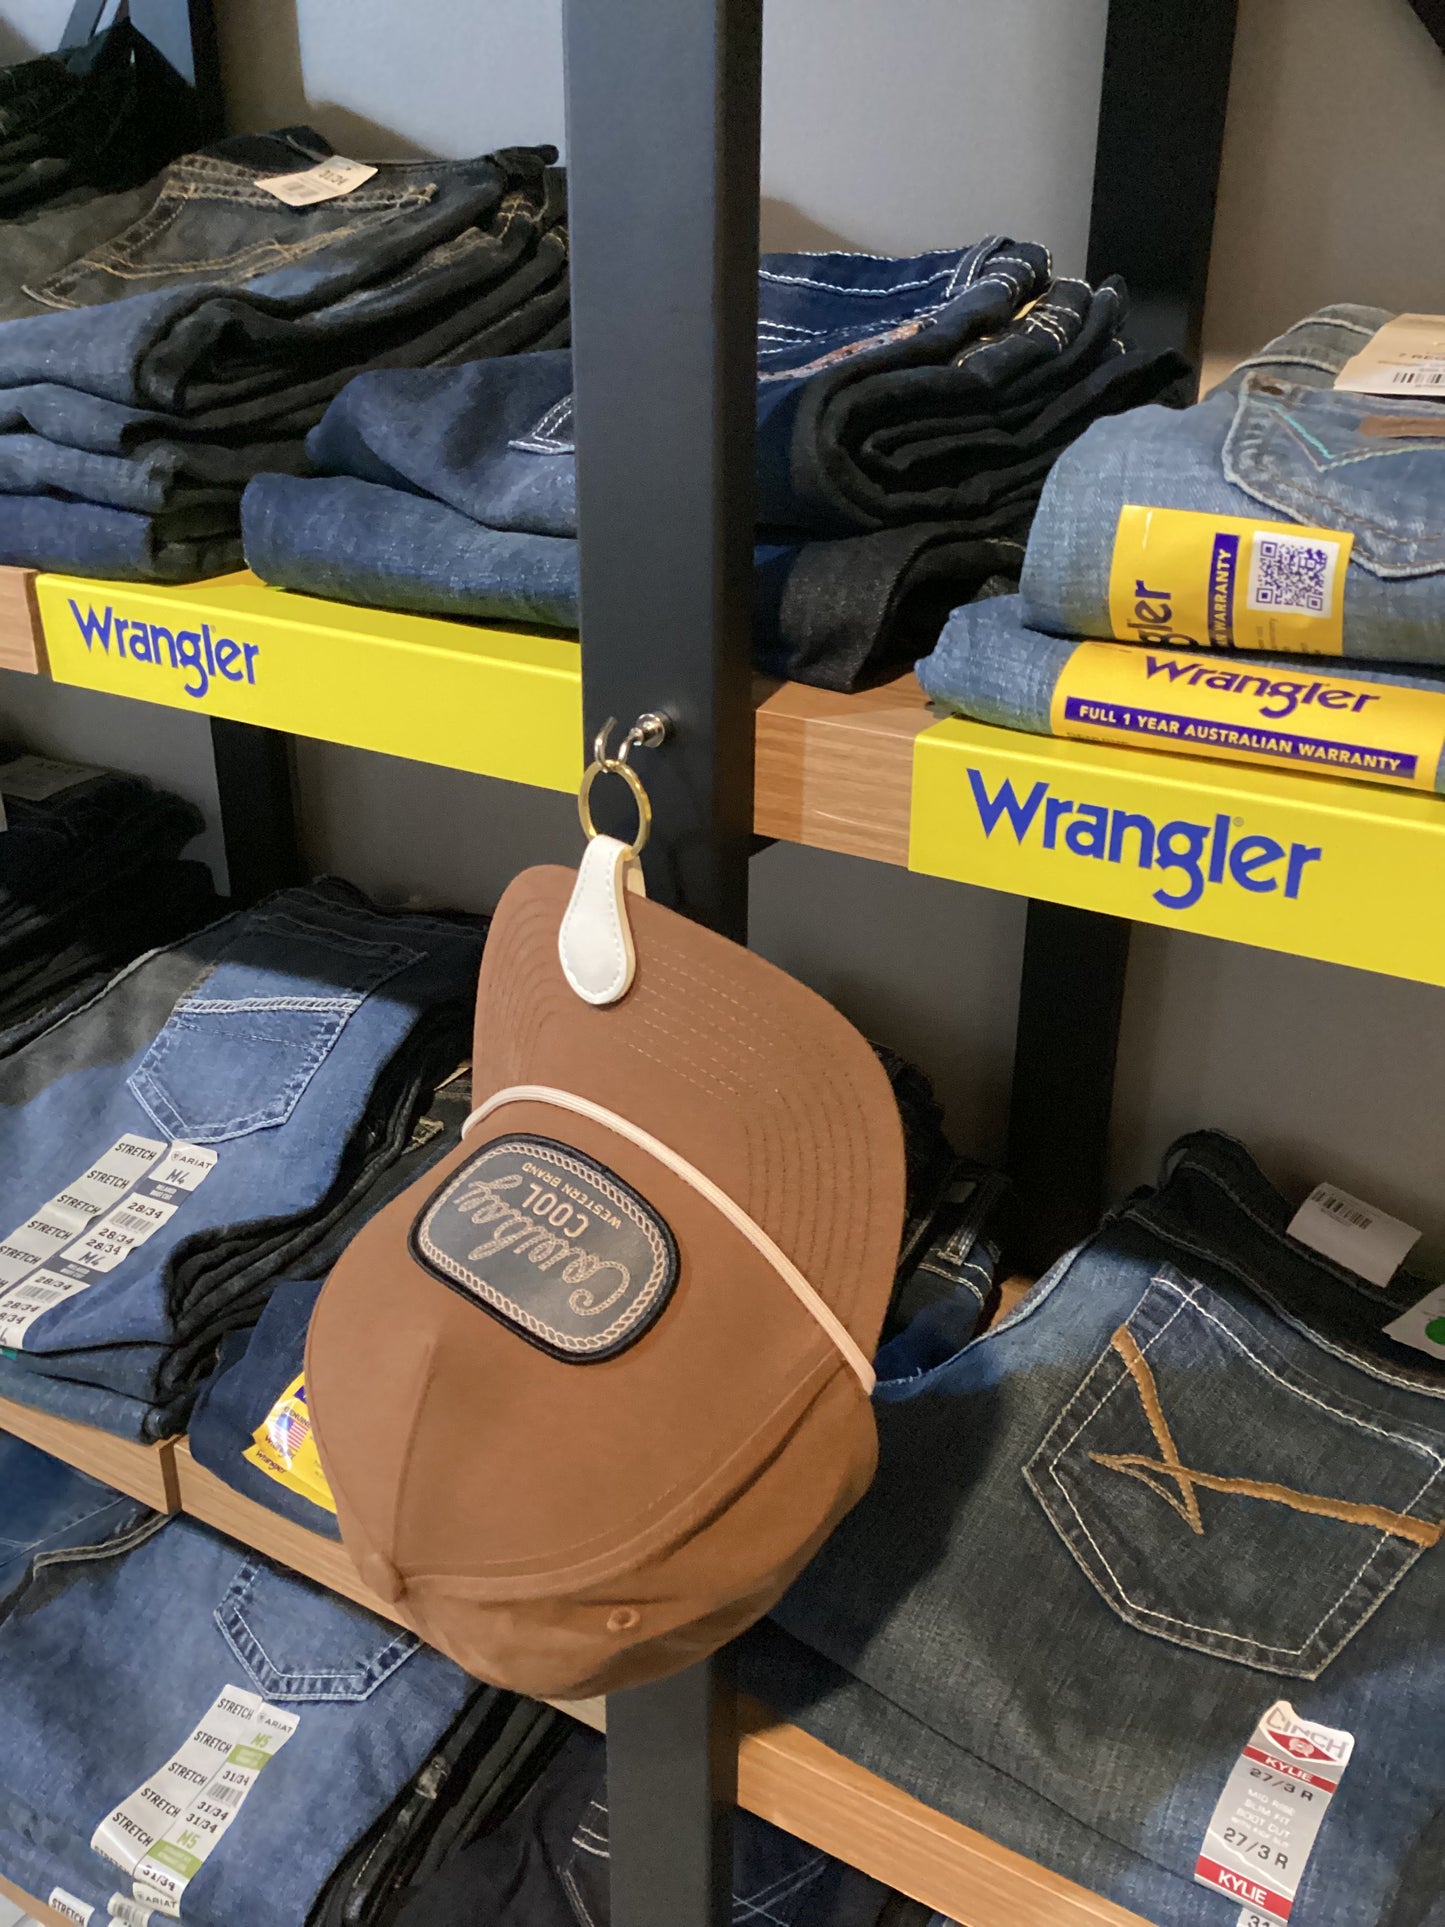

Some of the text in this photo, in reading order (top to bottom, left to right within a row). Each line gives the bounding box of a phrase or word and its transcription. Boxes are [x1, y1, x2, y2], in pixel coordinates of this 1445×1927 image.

[1213, 548, 1232, 634] WARRANTY
[67, 598, 259, 698] Wrangler
[1144, 655, 1380, 719] Wrangler
[1079, 705, 1401, 773] FULL 1 YEAR AUSTRALIAN WARRANTY
[966, 767, 1322, 910] Wrangler
[115, 1142, 157, 1161] STRETCH
[180, 1156, 212, 1169] ARIAT
[86, 1169, 130, 1190] STRETCH
[165, 1168, 190, 1185] M4
[56, 1194, 101, 1215] STRETCH
[521, 1161, 622, 1231] WESTERN BRAND
[127, 1202, 164, 1219] 28/34
[520, 1182, 589, 1239] COOL
[27, 1220, 73, 1240] STRETCH
[98, 1228, 135, 1245] 28/34
[0, 1245, 42, 1265] STRETCH
[85, 1239, 122, 1256] 28/34
[78, 1251, 106, 1267] M4
[34, 1275, 73, 1291] 28/34
[217, 1698, 255, 1721] STRETCH
[264, 1718, 294, 1734] ARIAT
[1266, 1706, 1349, 1759] CINCH
[193, 1730, 232, 1754] STRETCH
[168, 1762, 208, 1786] STRETCH
[222, 1770, 251, 1787] 31/34
[1264, 1756, 1315, 1782] KYLIE
[1249, 1767, 1314, 1802] 27/3 R
[140, 1787, 182, 1818] STRETCH
[197, 1801, 229, 1822] 31/34
[112, 1811, 155, 1847] STRETCH
[186, 1812, 218, 1834] 31/34
[175, 1829, 200, 1850] M5
[1223, 1826, 1271, 1860] 27/3
[1274, 1851, 1289, 1870] R
[1218, 1869, 1268, 1906] KYLIE
[51, 1897, 86, 1926] STRETCH
[145, 1895, 178, 1909] ARIAT
